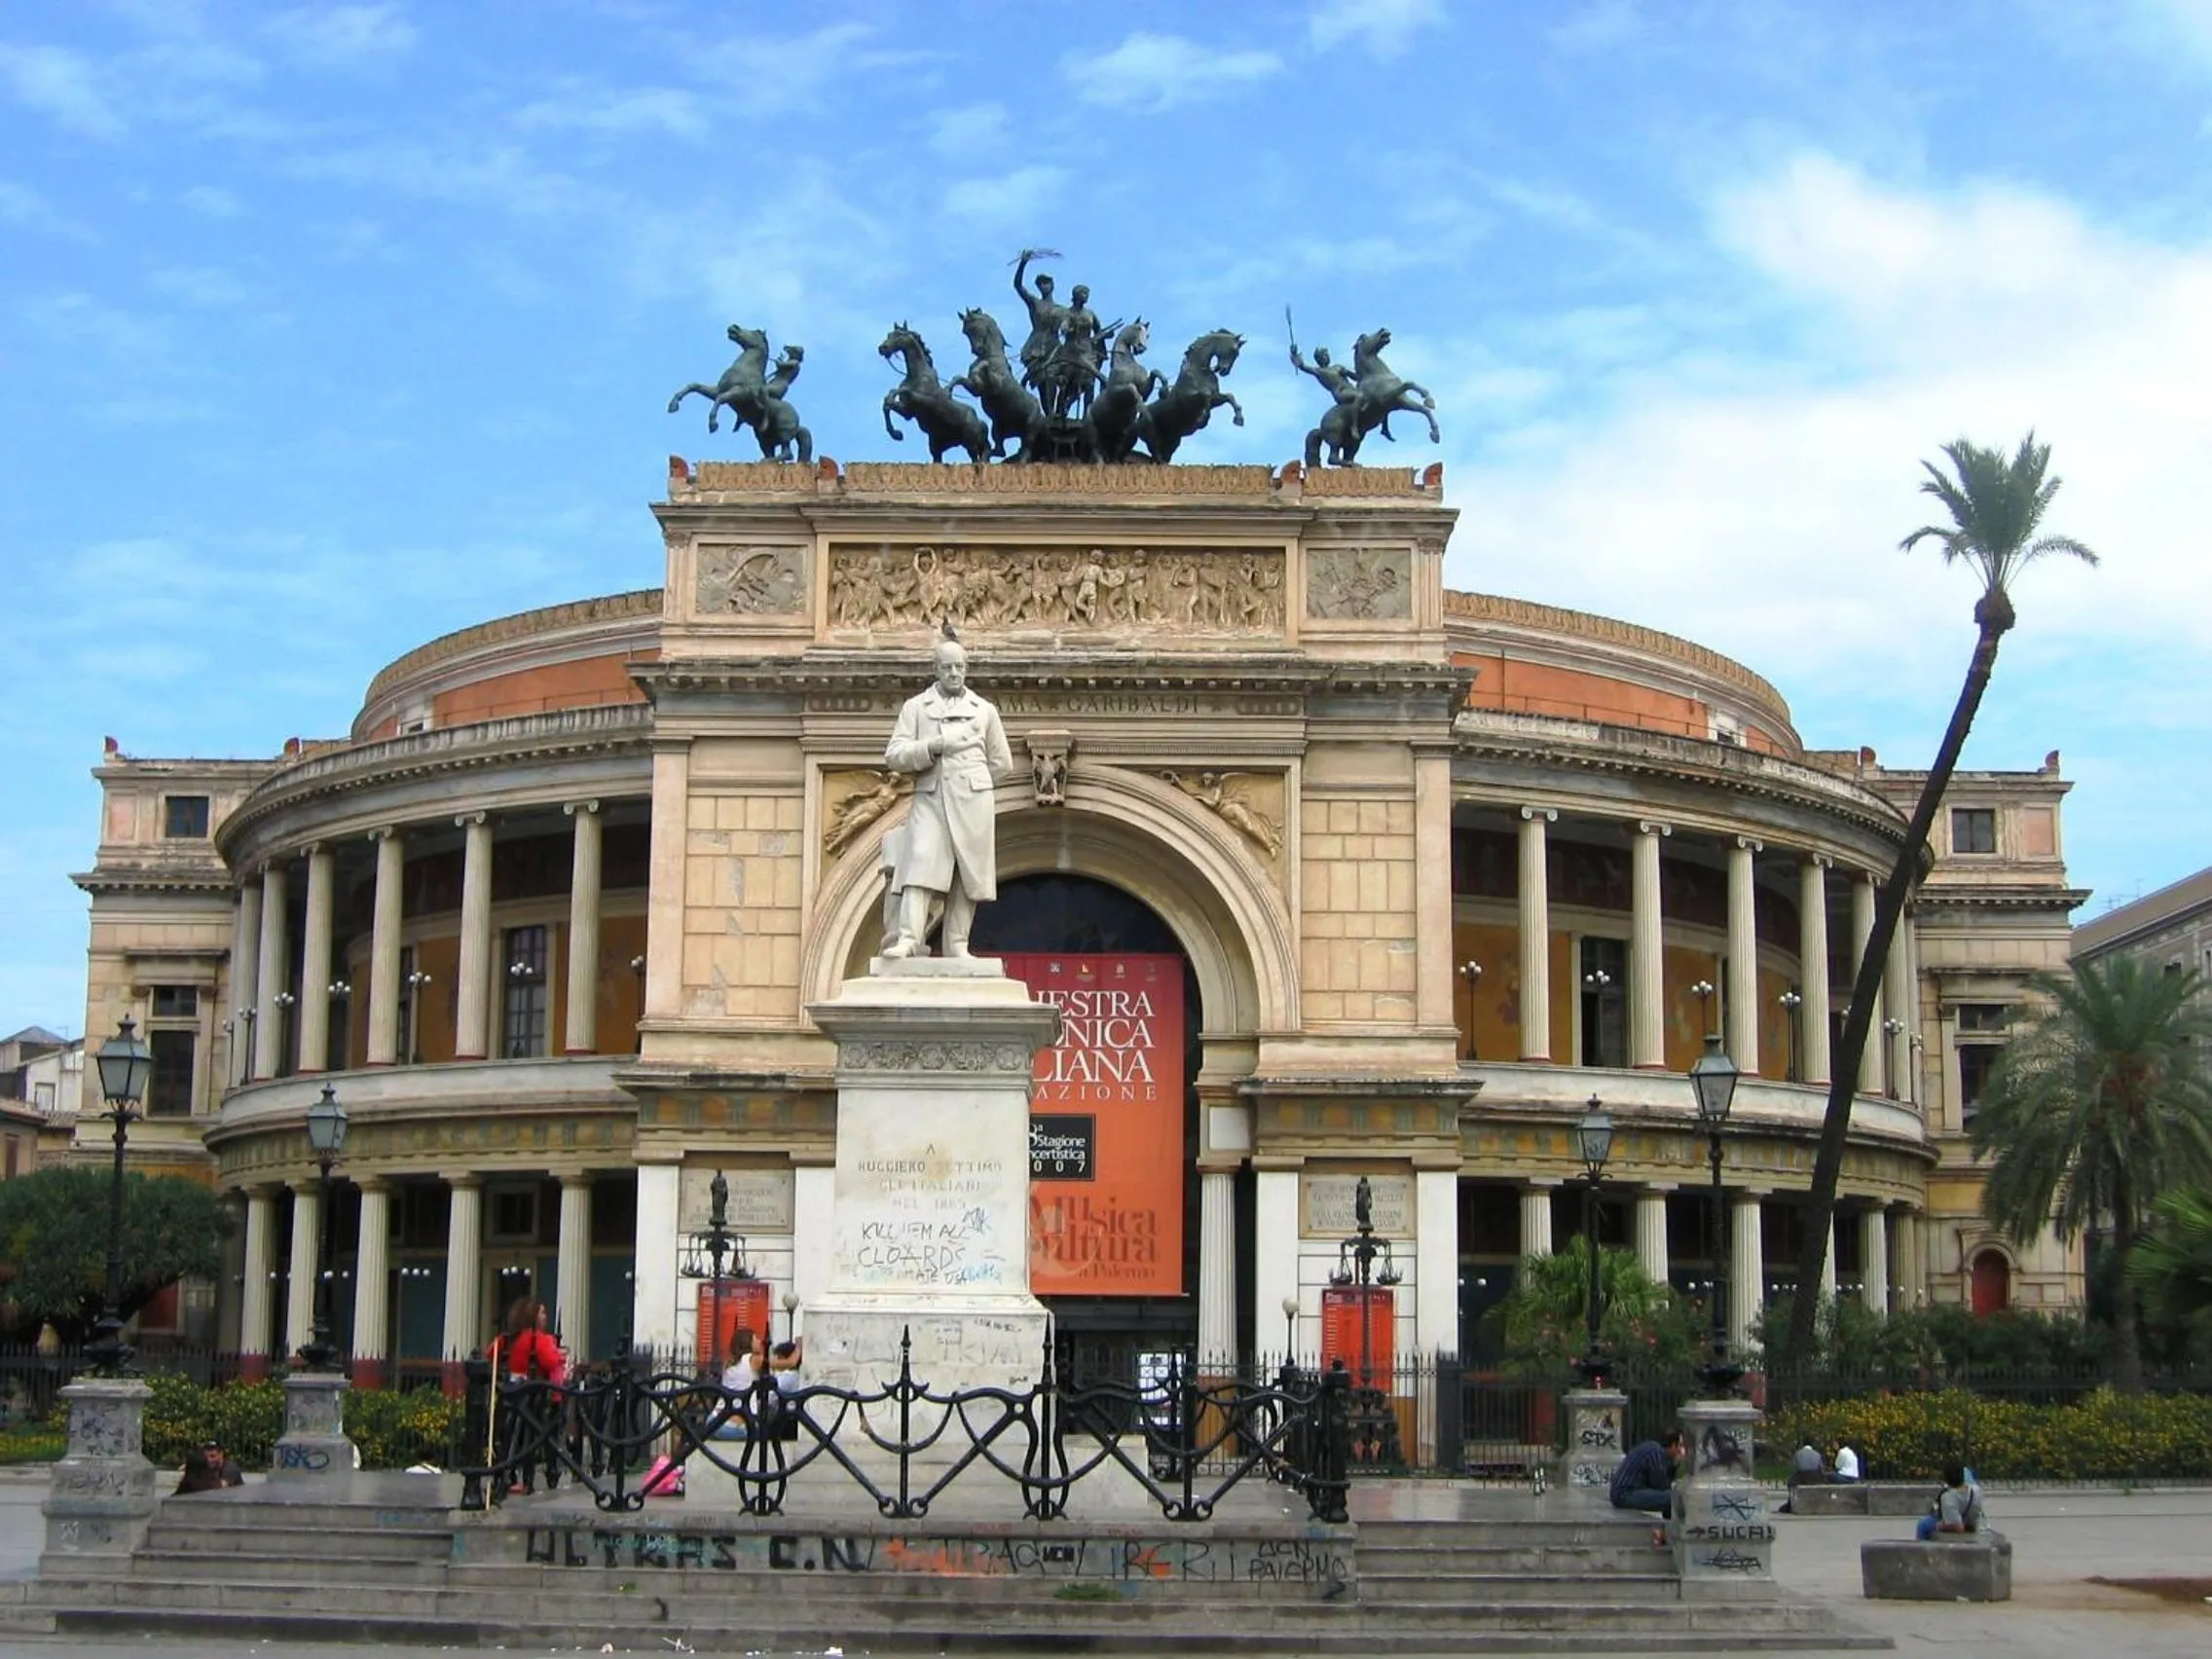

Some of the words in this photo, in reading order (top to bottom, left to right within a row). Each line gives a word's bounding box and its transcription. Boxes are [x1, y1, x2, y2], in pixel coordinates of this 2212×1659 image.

[1067, 694, 1198, 714] GARIBALDI
[1054, 1018, 1156, 1049] NICA
[1035, 1085, 1158, 1101] AZIONE
[1028, 1148, 1087, 1161] ncertistica
